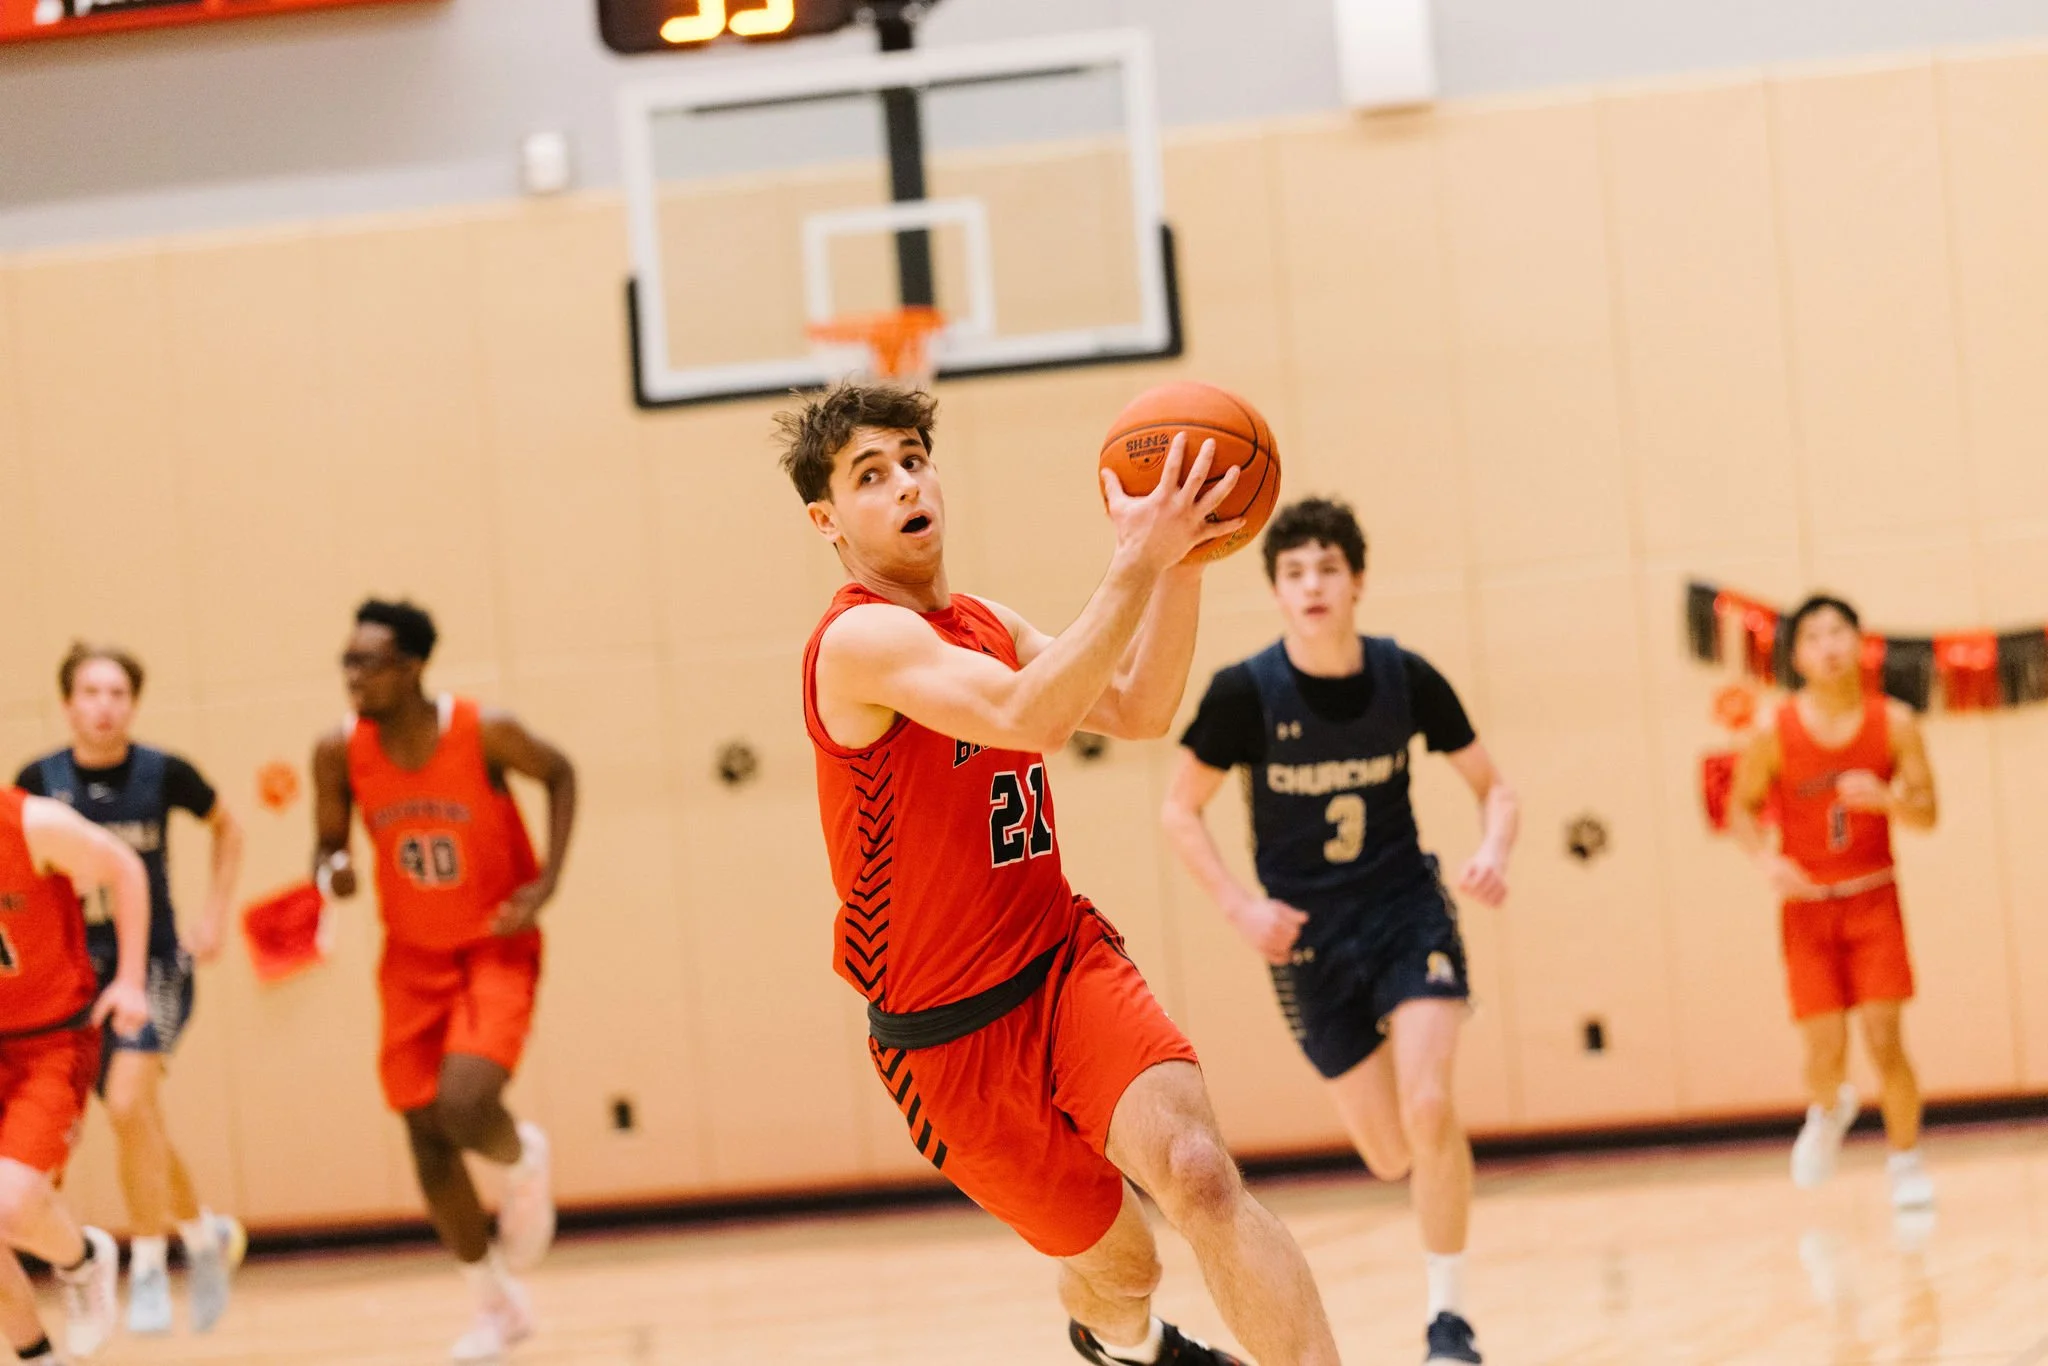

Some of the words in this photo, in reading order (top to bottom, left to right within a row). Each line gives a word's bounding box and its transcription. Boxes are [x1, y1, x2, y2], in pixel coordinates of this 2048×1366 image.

[989, 762, 1053, 868] 21
[1323, 793, 1366, 863] 3
[398, 834, 461, 884] 40
